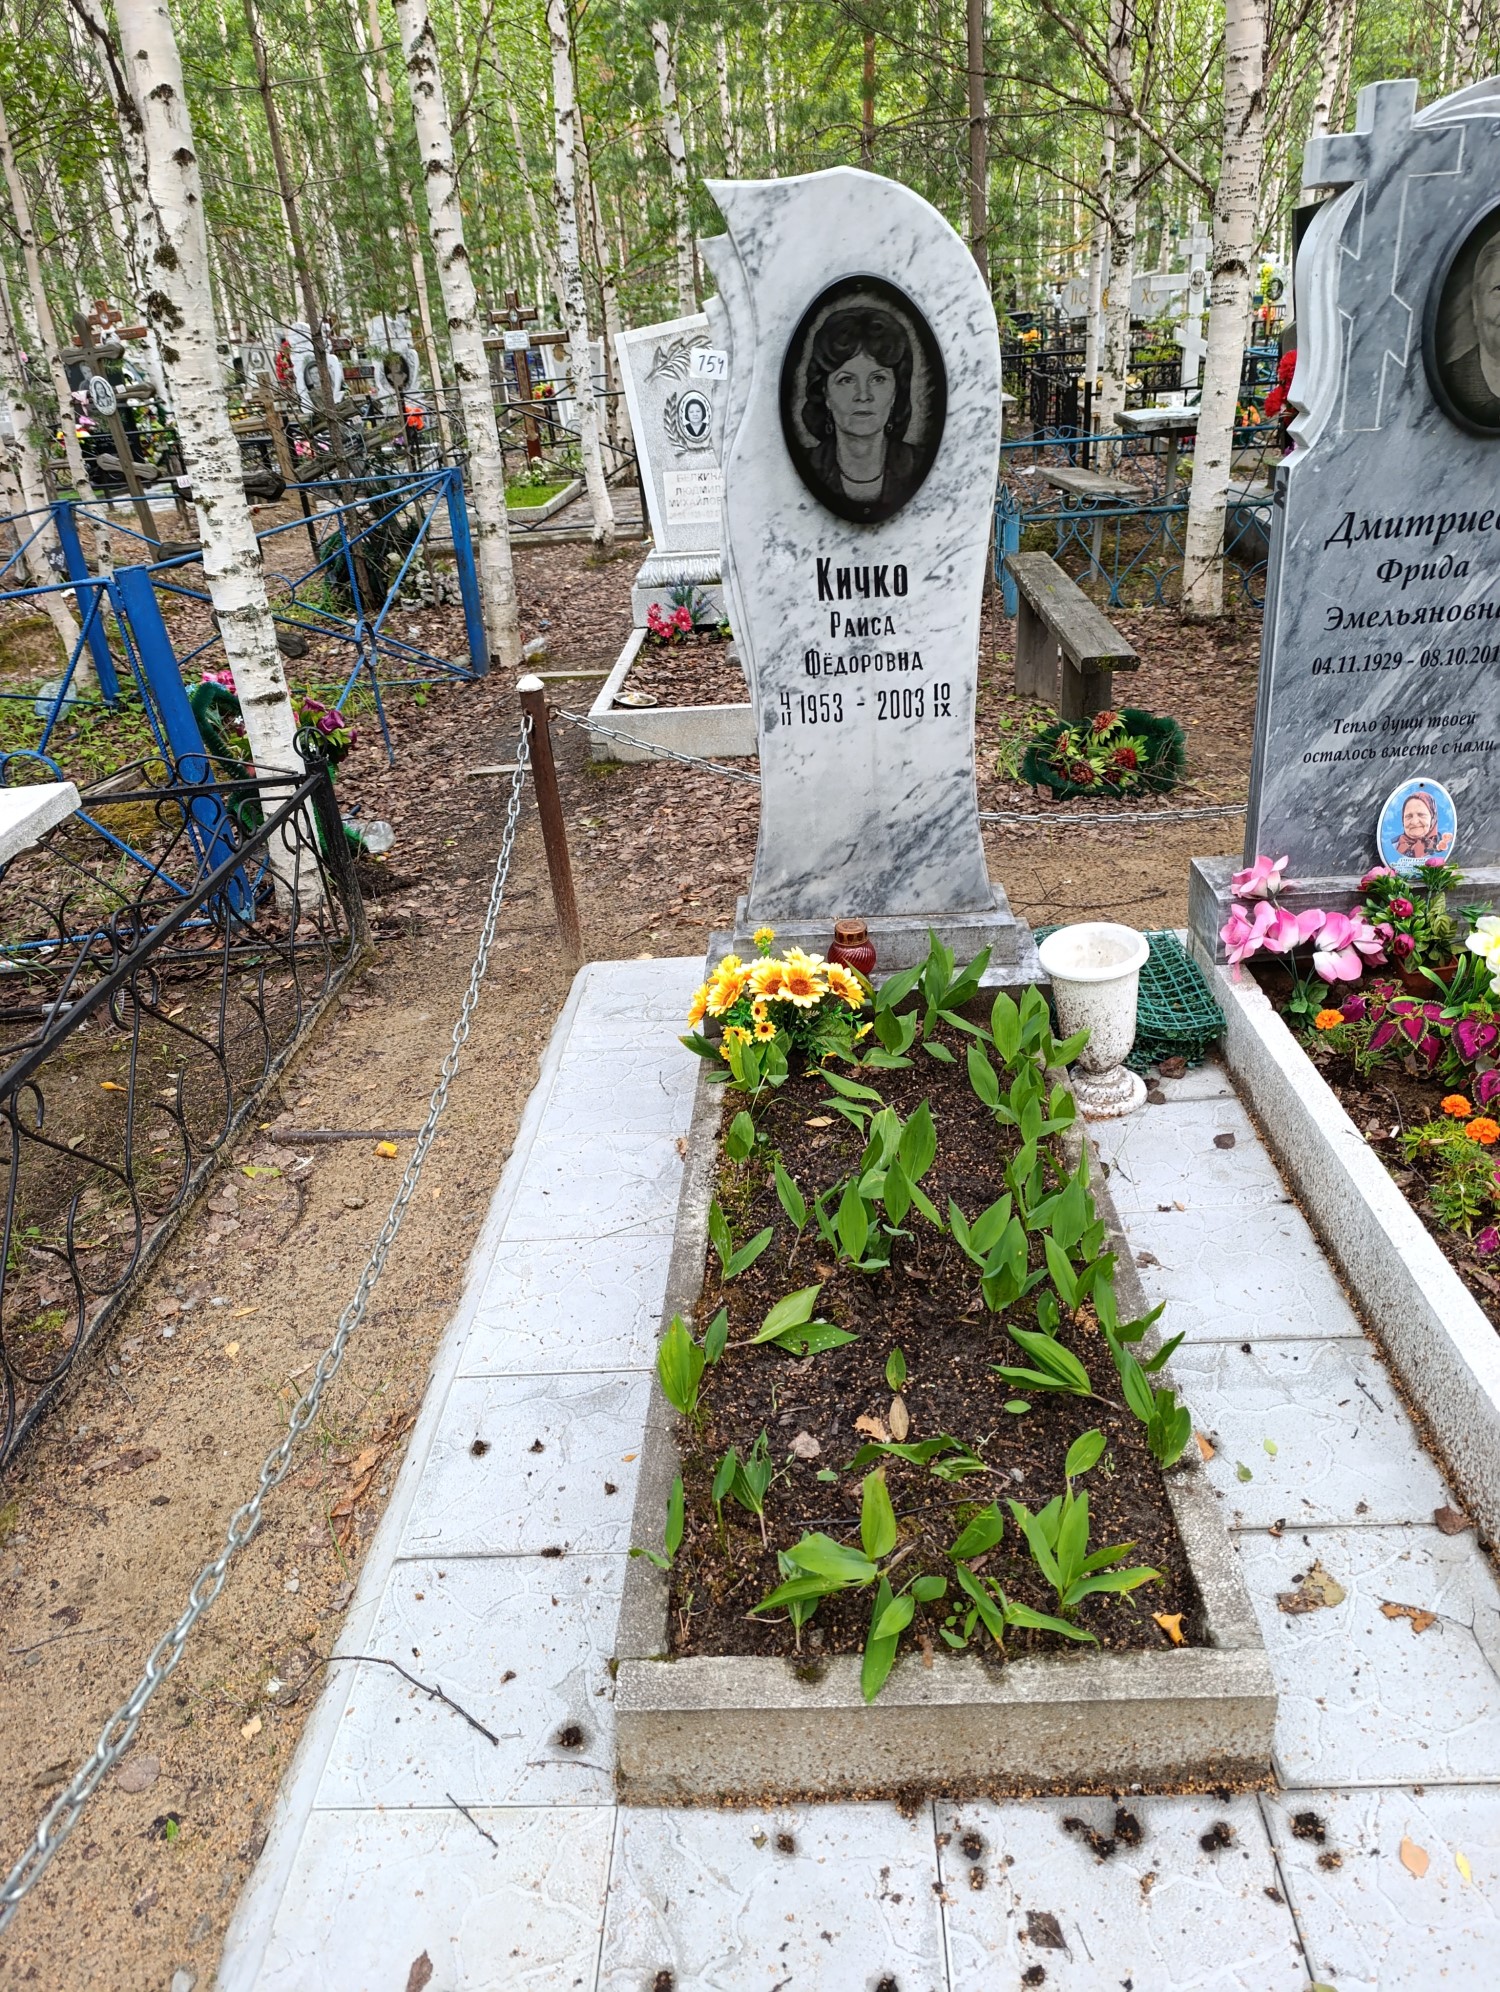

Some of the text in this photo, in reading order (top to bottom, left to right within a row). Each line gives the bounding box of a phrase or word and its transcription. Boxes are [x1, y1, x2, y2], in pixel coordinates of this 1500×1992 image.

[669, 496, 722, 507] МИХАЙЛОВ
[675, 485, 721, 495] ЛЮДМИЛ
[816, 557, 908, 601] КИЧКО
[1376, 554, 1470, 591] Фрида
[830, 611, 896, 638] РАИСА
[805, 648, 923, 679] ФЁДОРОВНА
[1312, 651, 1403, 675] 04.11.1929
[1420, 645, 1500, 668] 08.10.201
[934, 682, 951, 701] 10
[801, 692, 843, 724] 1953
[877, 688, 924, 720] 2003
[1333, 711, 1476, 736] Тепло души твоей
[1303, 740, 1498, 763] осталось вместе с нами.
